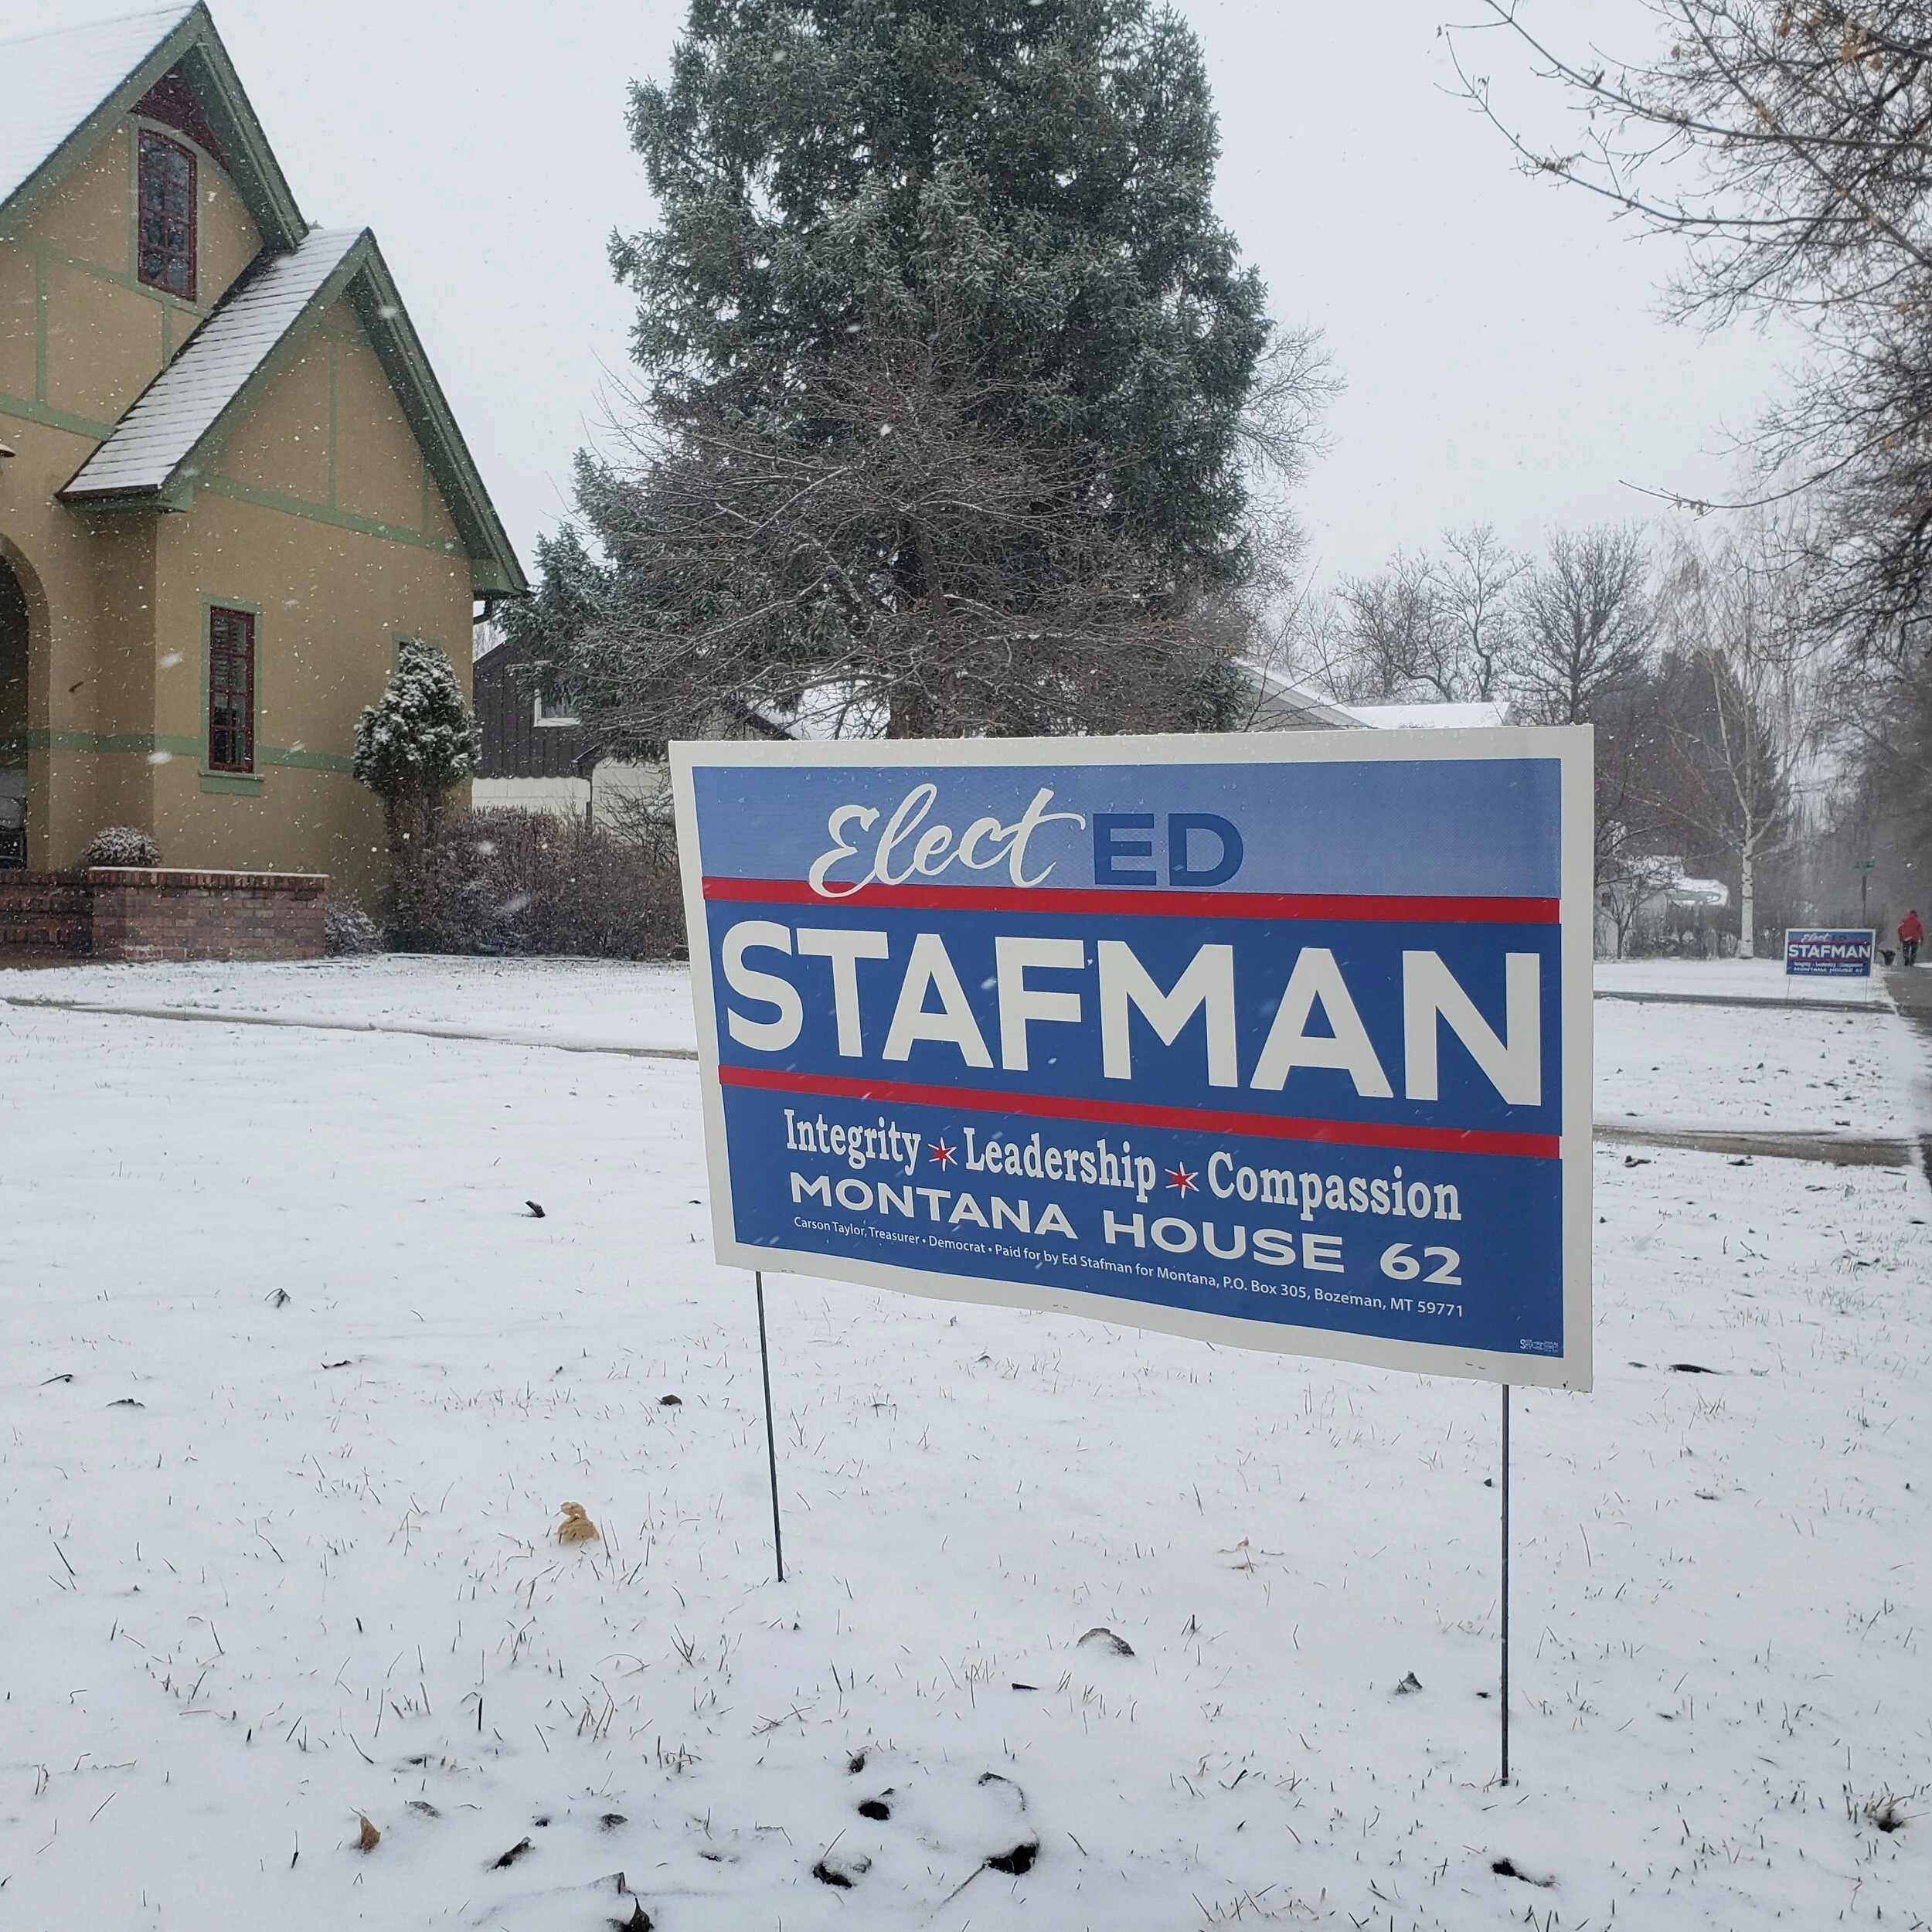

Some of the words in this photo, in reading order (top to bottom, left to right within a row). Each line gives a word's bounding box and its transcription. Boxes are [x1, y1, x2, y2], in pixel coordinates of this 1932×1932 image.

[808, 784, 1086, 898] Elect
[1094, 812, 1243, 886] ED
[1788, 944, 1871, 958] STAFMAN
[721, 921, 1541, 1106] STAFMAN
[784, 1108, 921, 1175] Integrity
[963, 1128, 1156, 1202] Leadership
[1208, 1151, 1462, 1221] Compassion
[790, 1172, 1078, 1240] MONTANA
[1104, 1209, 1344, 1273] HOUSE
[1380, 1243, 1462, 1286] 62
[794, 1216, 831, 1231] Carson
[832, 1222, 867, 1237] Taylor,
[868, 1226, 920, 1244] Treasurer
[929, 1235, 985, 1254] Democrat
[995, 1244, 1021, 1259] Paid
[1023, 1247, 1041, 1261] for
[1043, 1250, 1059, 1265] by
[1062, 1253, 1077, 1266] Ed
[1080, 1255, 1133, 1274] Stafman
[1135, 1262, 1154, 1277] for
[1157, 1267, 1219, 1287] Montana,
[1223, 1276, 1247, 1291] P.O.
[1251, 1279, 1277, 1295] Box
[1281, 1284, 1311, 1300] 305,
[1315, 1287, 1386, 1310] Bozeman,
[1390, 1298, 1413, 1312] MT
[1417, 1301, 1463, 1317] 59771
